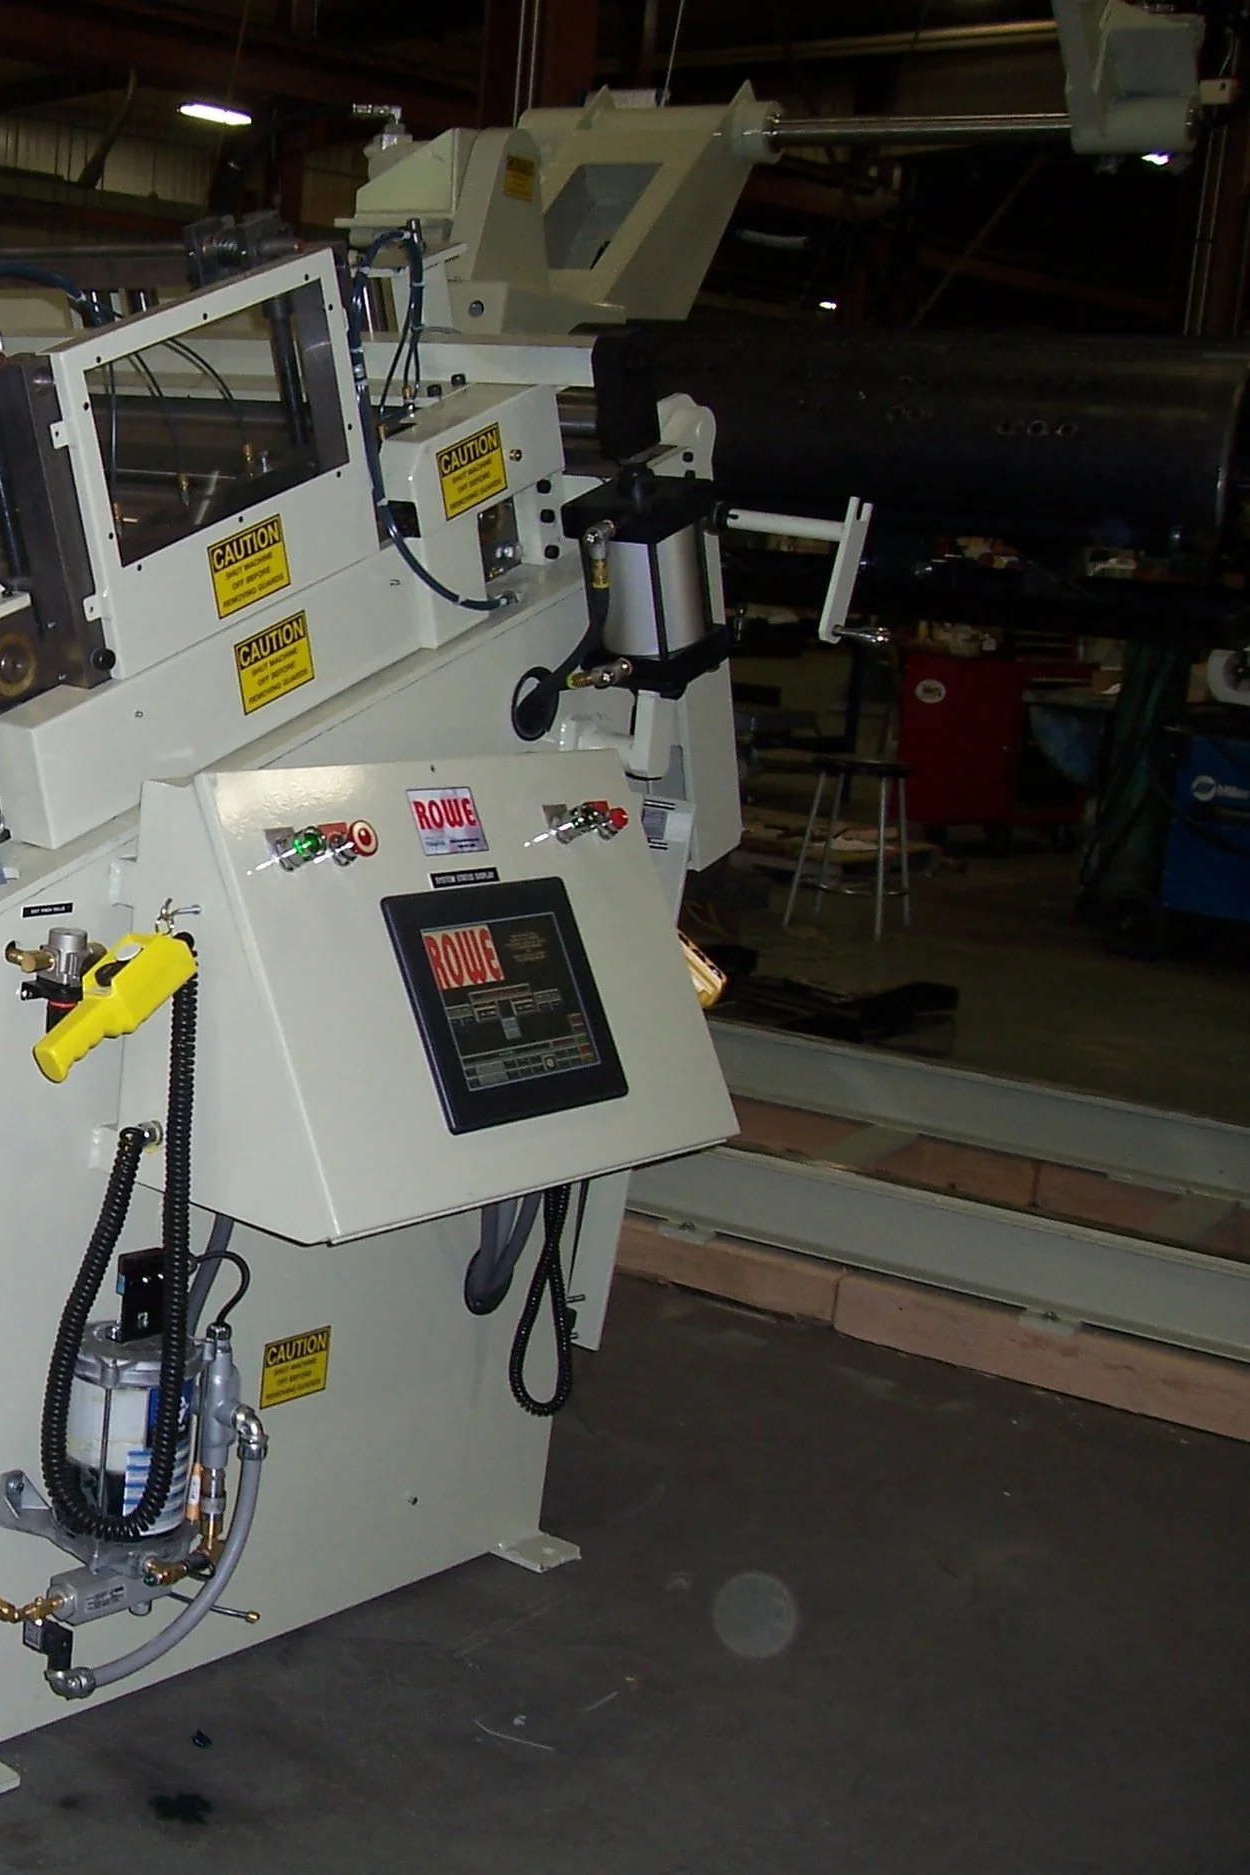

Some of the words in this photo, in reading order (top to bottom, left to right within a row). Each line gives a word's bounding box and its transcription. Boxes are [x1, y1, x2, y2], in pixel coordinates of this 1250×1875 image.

[441, 430, 498, 474] CAUTION
[213, 522, 280, 570] CAUTION
[239, 618, 304, 667] CAUTION
[424, 927, 504, 991] ROWE
[267, 1332, 327, 1365] CAUTION
